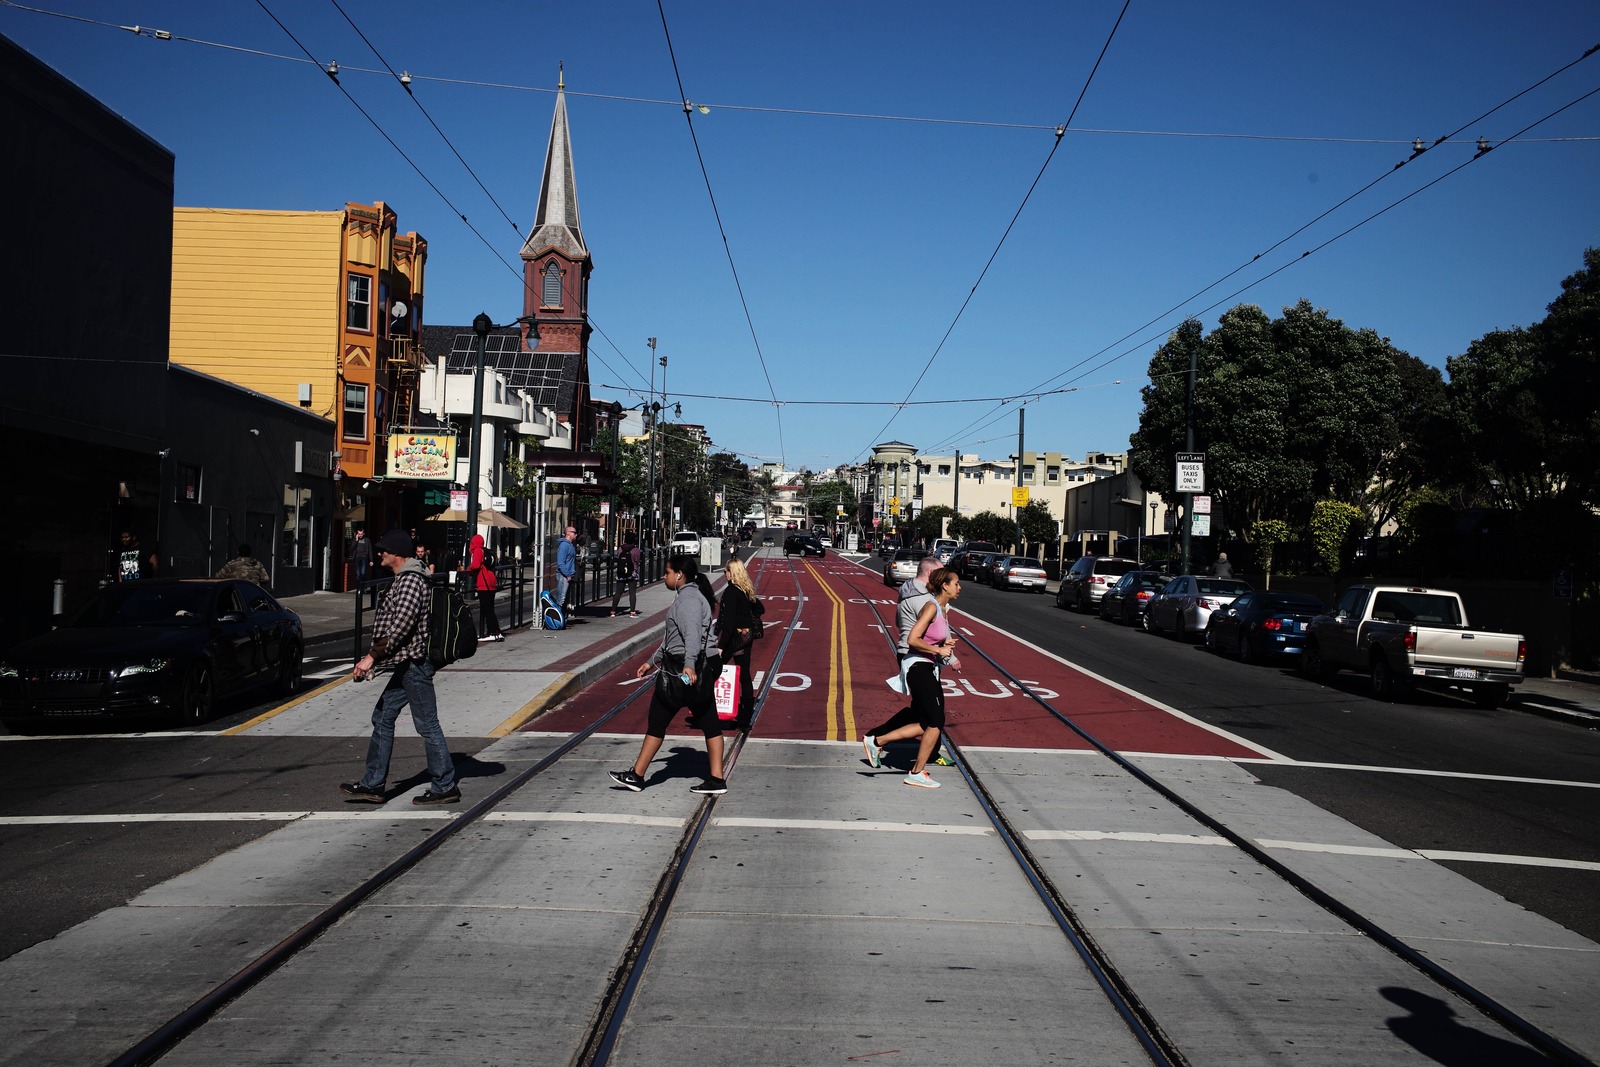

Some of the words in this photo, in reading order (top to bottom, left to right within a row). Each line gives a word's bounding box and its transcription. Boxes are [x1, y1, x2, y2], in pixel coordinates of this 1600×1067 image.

[408, 437, 436, 446] CASA
[394, 446, 450, 460] MEXICANA
[394, 469, 420, 477] MEXICAN
[939, 678, 1060, 699] BUS
[716, 689, 731, 699] LE
